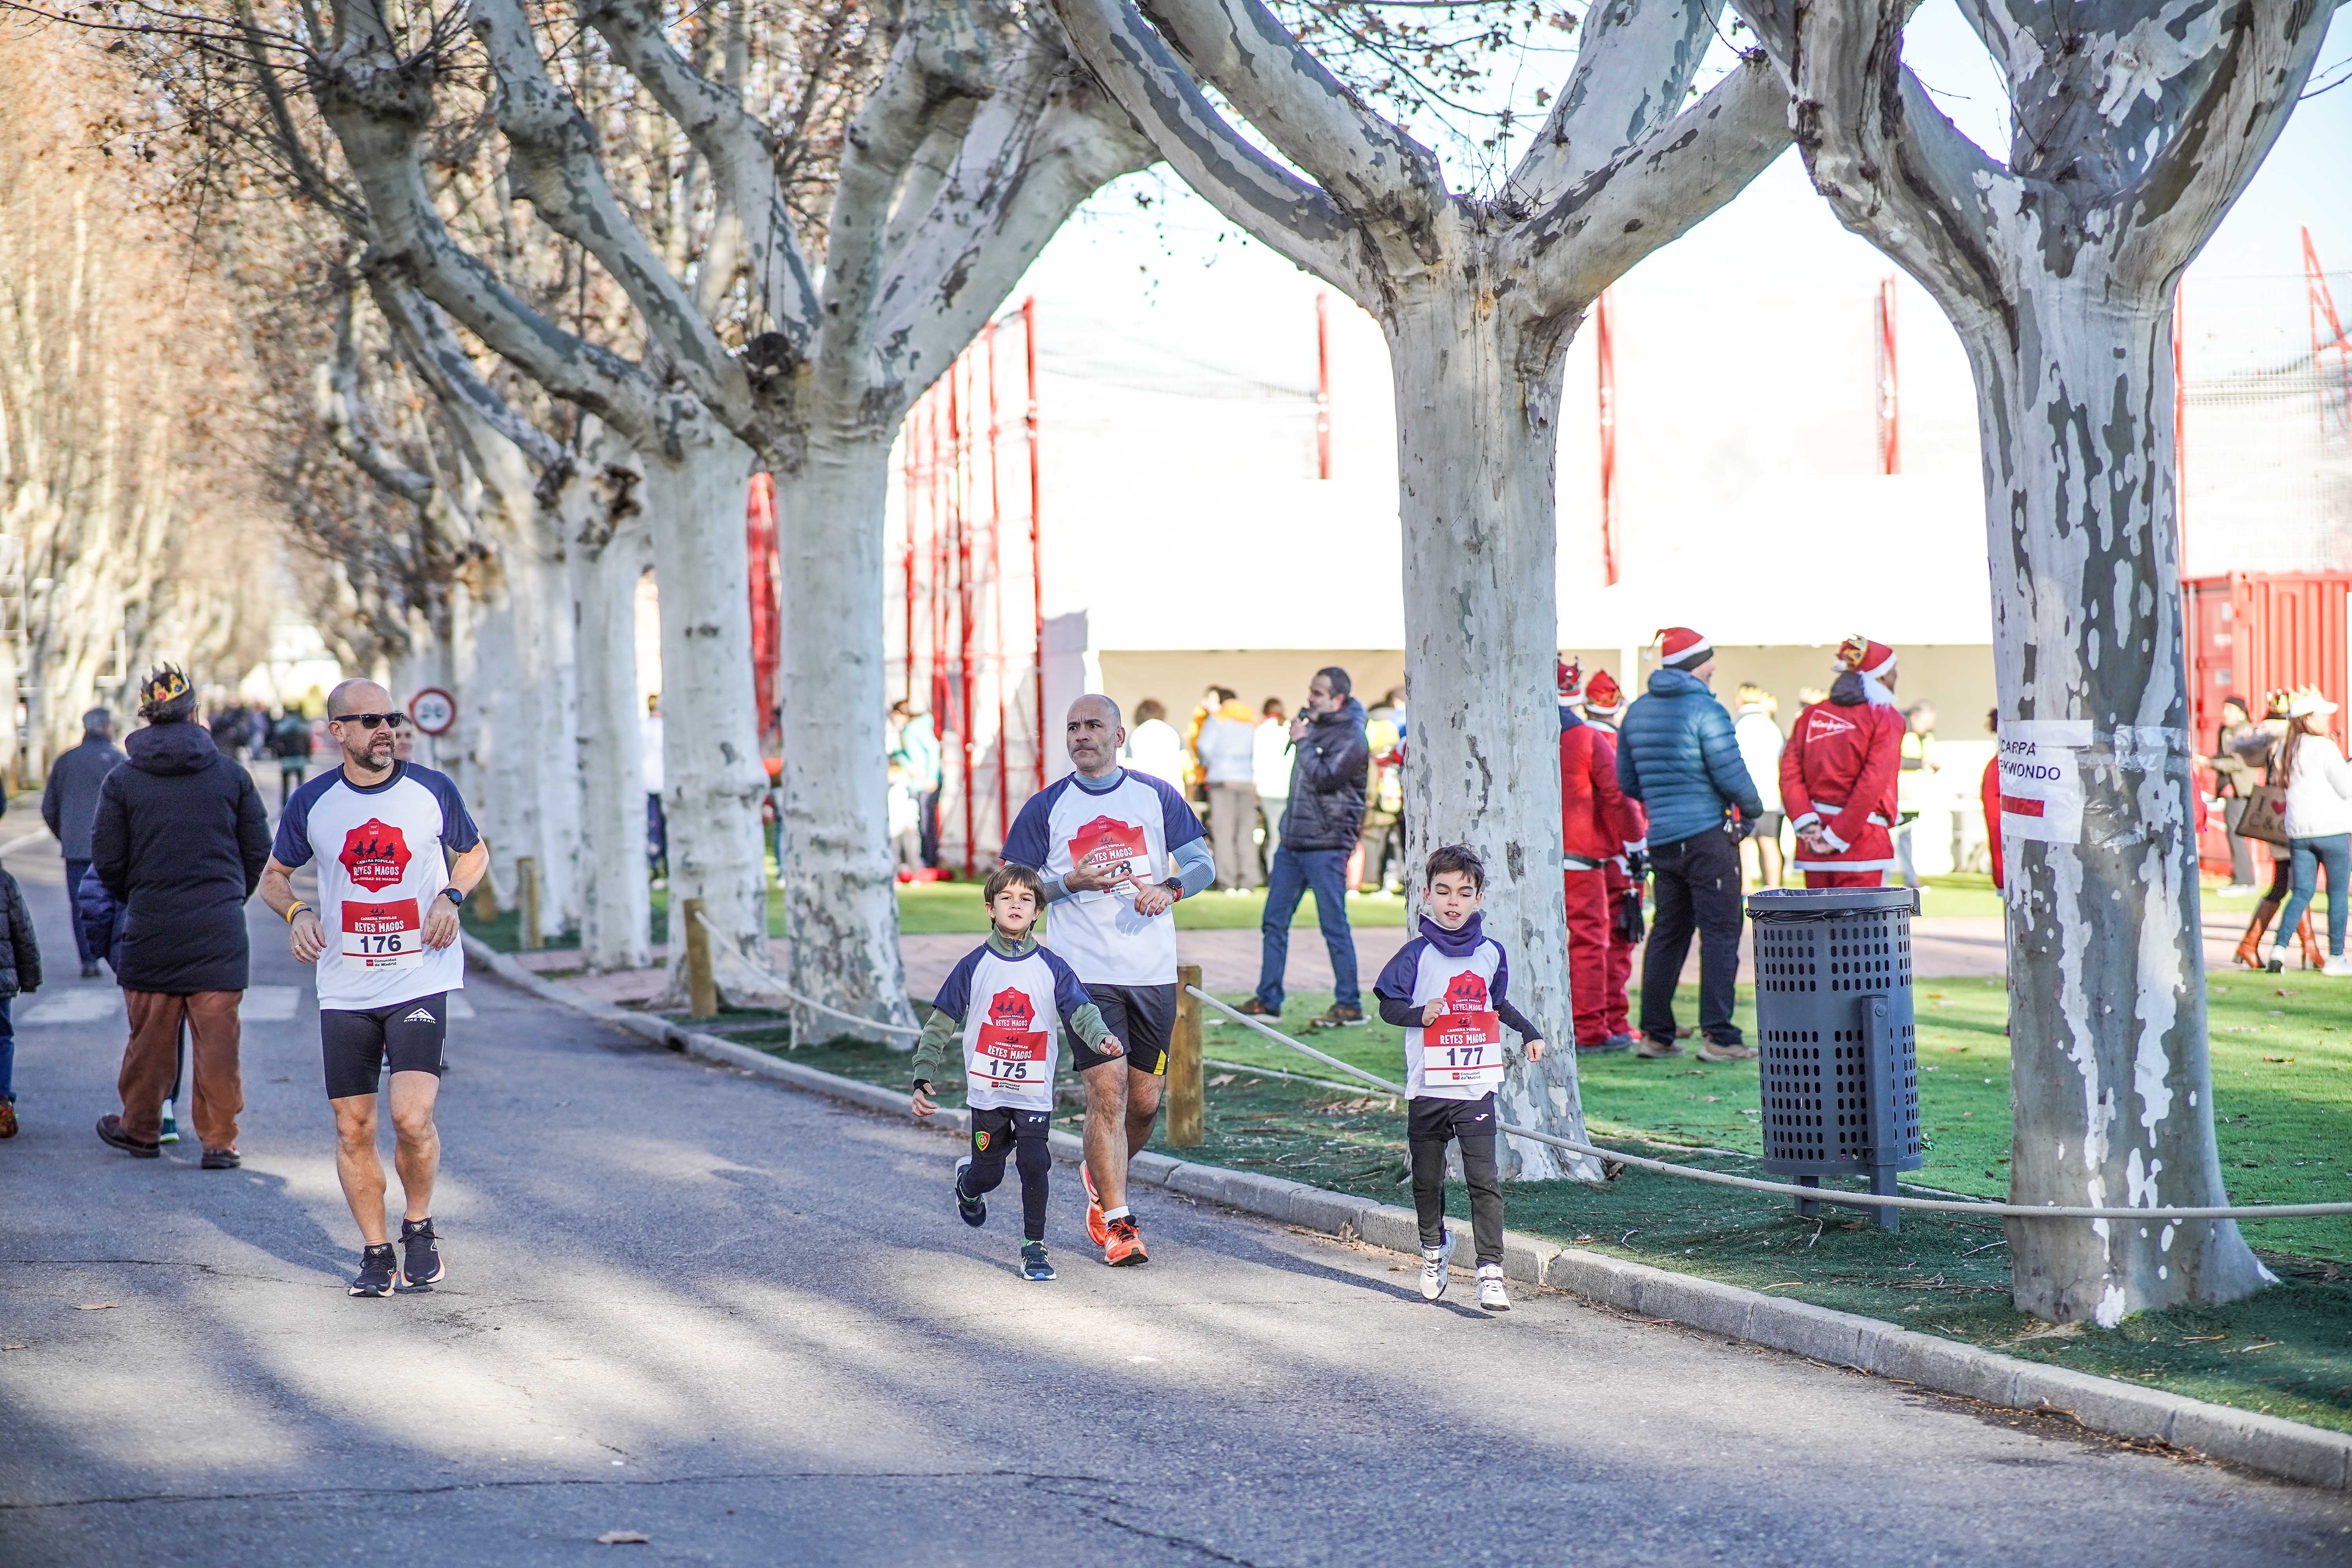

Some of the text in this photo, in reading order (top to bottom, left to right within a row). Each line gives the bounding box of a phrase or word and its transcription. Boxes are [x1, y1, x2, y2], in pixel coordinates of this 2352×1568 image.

[2001, 740, 2036, 756] CARPA
[1109, 847, 1132, 860] MAGOS
[375, 866, 399, 875] MAGOS
[355, 920, 404, 933] REYES MAGOS
[360, 935, 401, 953] 176
[1440, 1033, 1486, 1044] REYES MAGOS
[987, 1045, 1032, 1060] REYES MAGOS
[1446, 1047, 1483, 1066] 177
[990, 1060, 1027, 1079] 175
